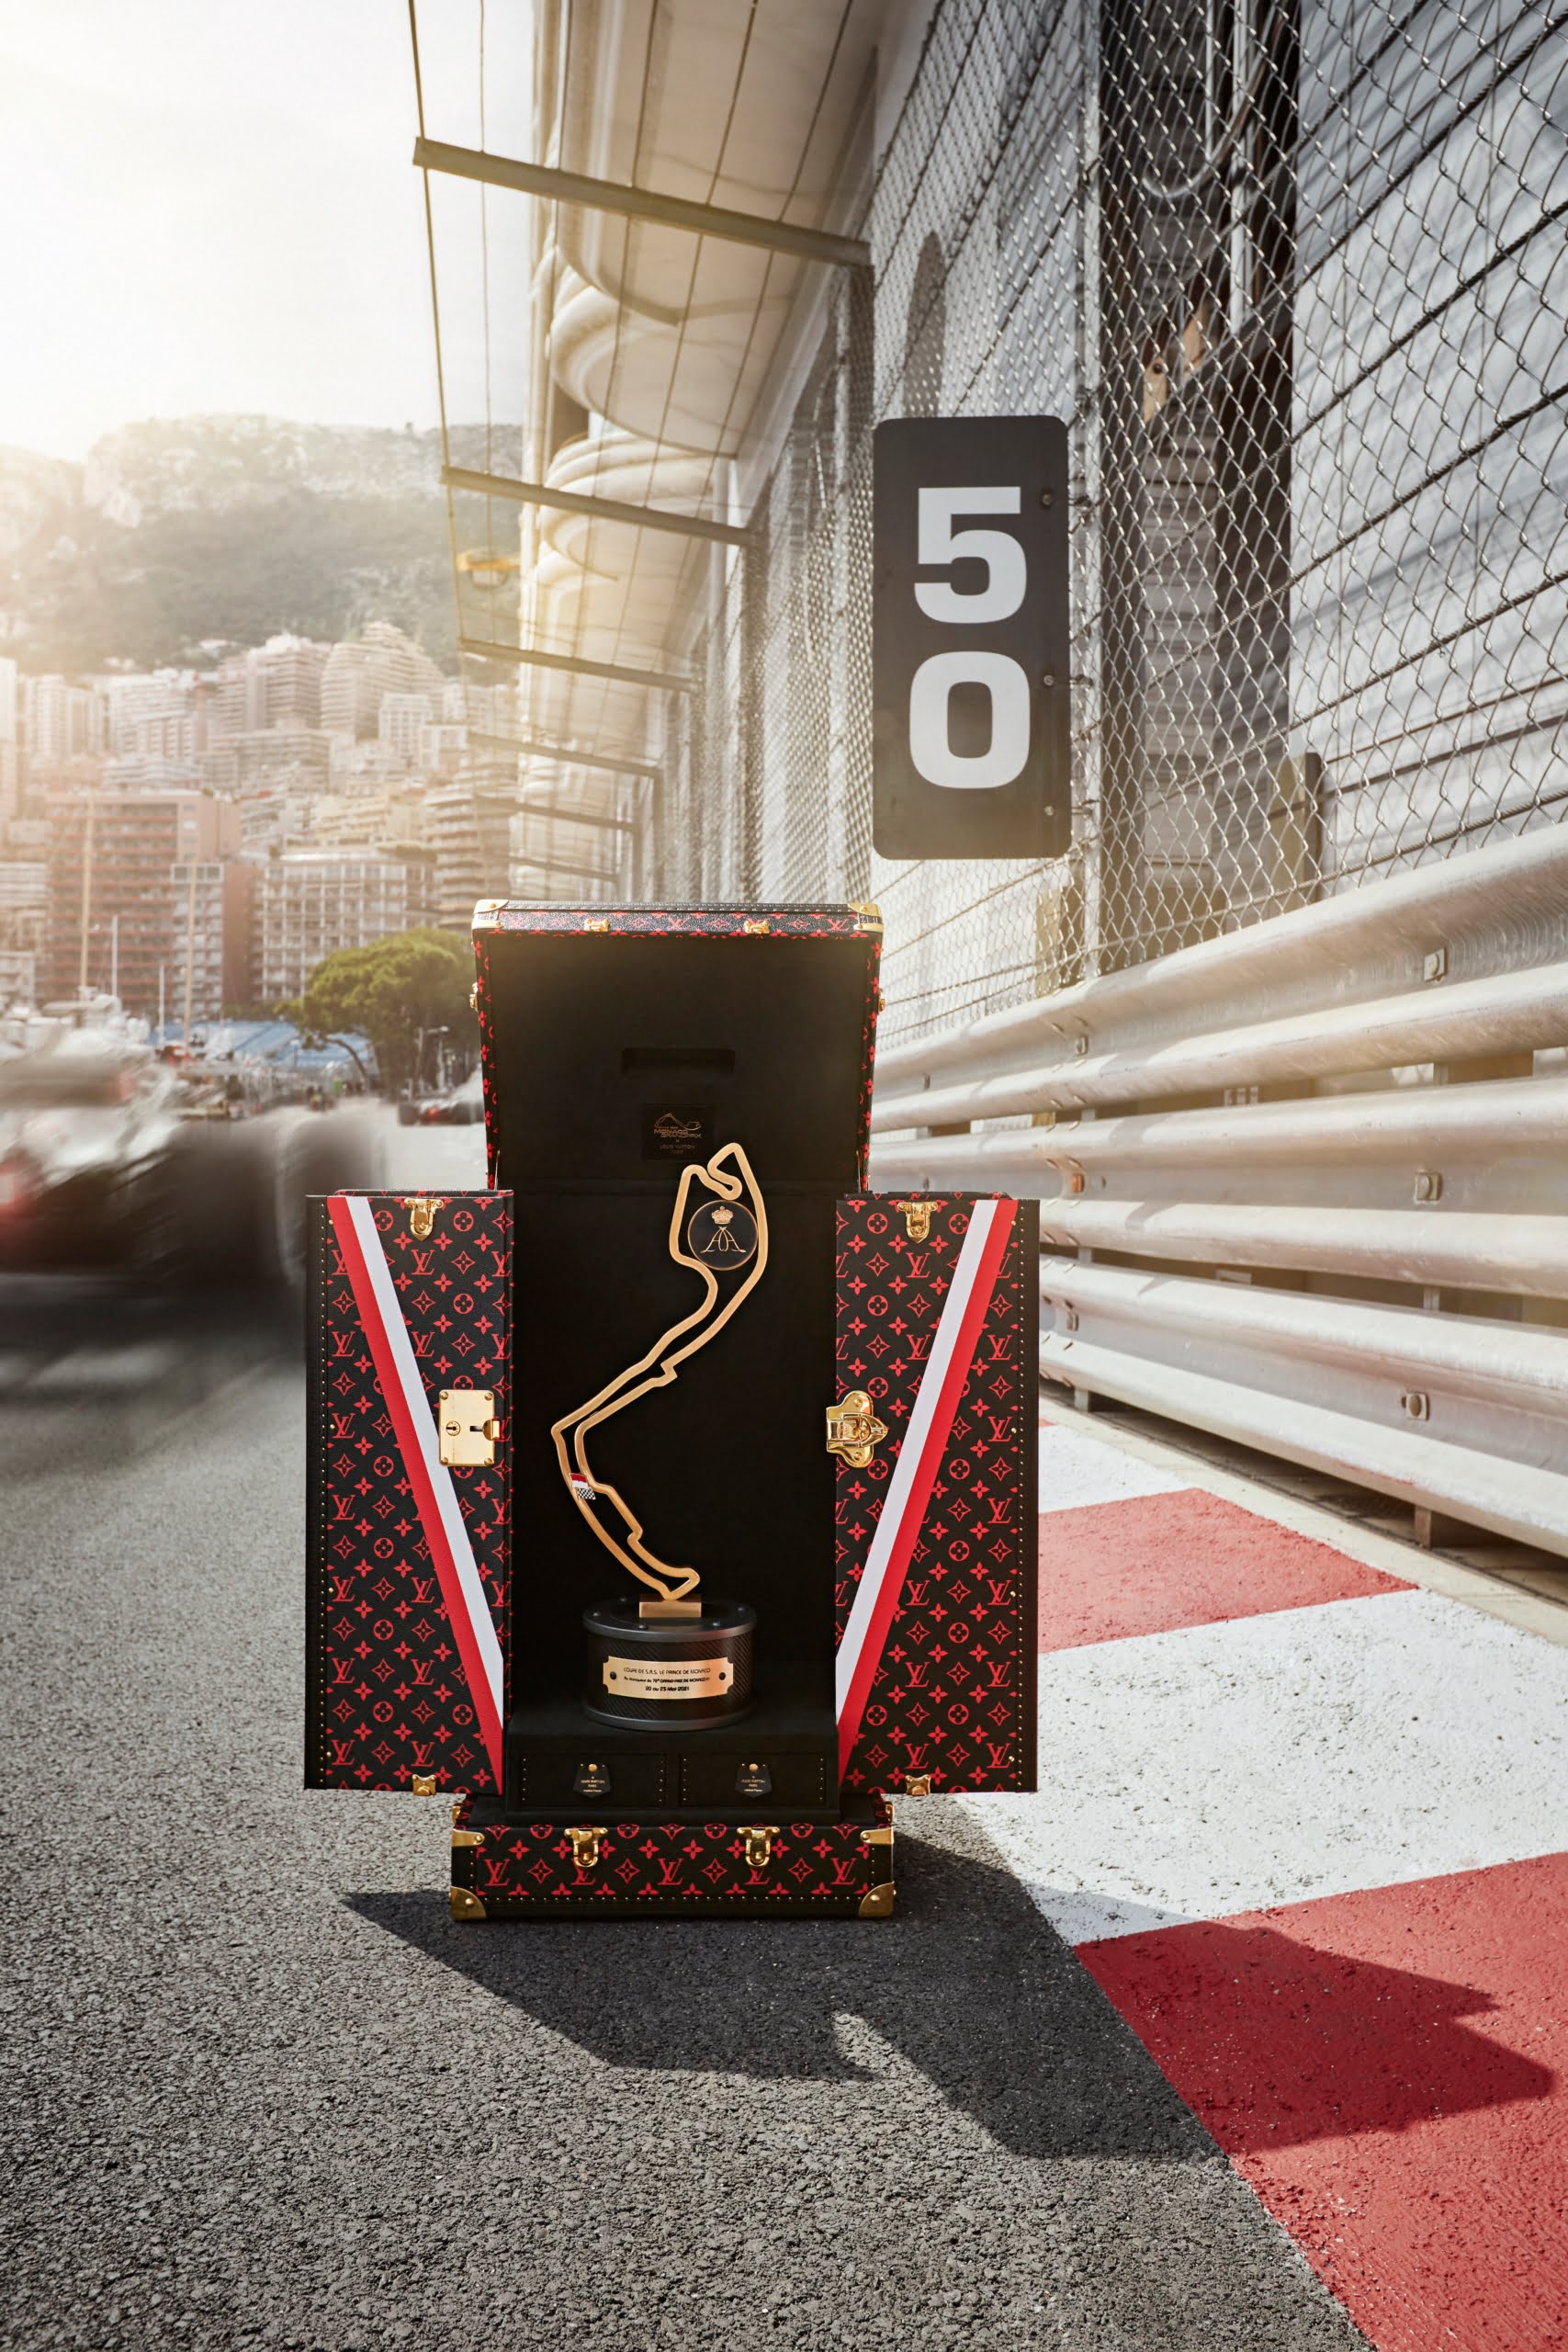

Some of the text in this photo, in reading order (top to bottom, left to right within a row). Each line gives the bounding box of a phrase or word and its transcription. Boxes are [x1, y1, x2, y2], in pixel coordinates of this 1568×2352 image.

[909, 486, 1031, 788] 50
[826, 918, 852, 932] LV
[412, 1249, 435, 1275] LV
[906, 1251, 931, 1279] LV
[332, 1330, 356, 1357] LV
[412, 1330, 435, 1358] LV
[906, 1333, 932, 1361] LV
[987, 1334, 1013, 1361] LV
[332, 1412, 355, 1439] LV
[987, 1416, 1014, 1442] LV
[333, 1494, 356, 1521] LV
[987, 1498, 1013, 1524] LV
[333, 1576, 356, 1602] LV
[412, 1577, 435, 1603] LV
[905, 1579, 931, 1606] LV
[987, 1579, 1013, 1606] LV
[332, 1657, 355, 1684] LV
[412, 1658, 434, 1685] LV
[905, 1661, 931, 1688] LV
[987, 1660, 1012, 1688] LV
[332, 1739, 355, 1766] LV
[412, 1740, 435, 1767] LV
[905, 1742, 930, 1770] LV
[986, 1742, 1012, 1769] LV
[484, 1859, 511, 1886] LV
[658, 1858, 684, 1885] LV
[830, 1857, 857, 1885] LV
